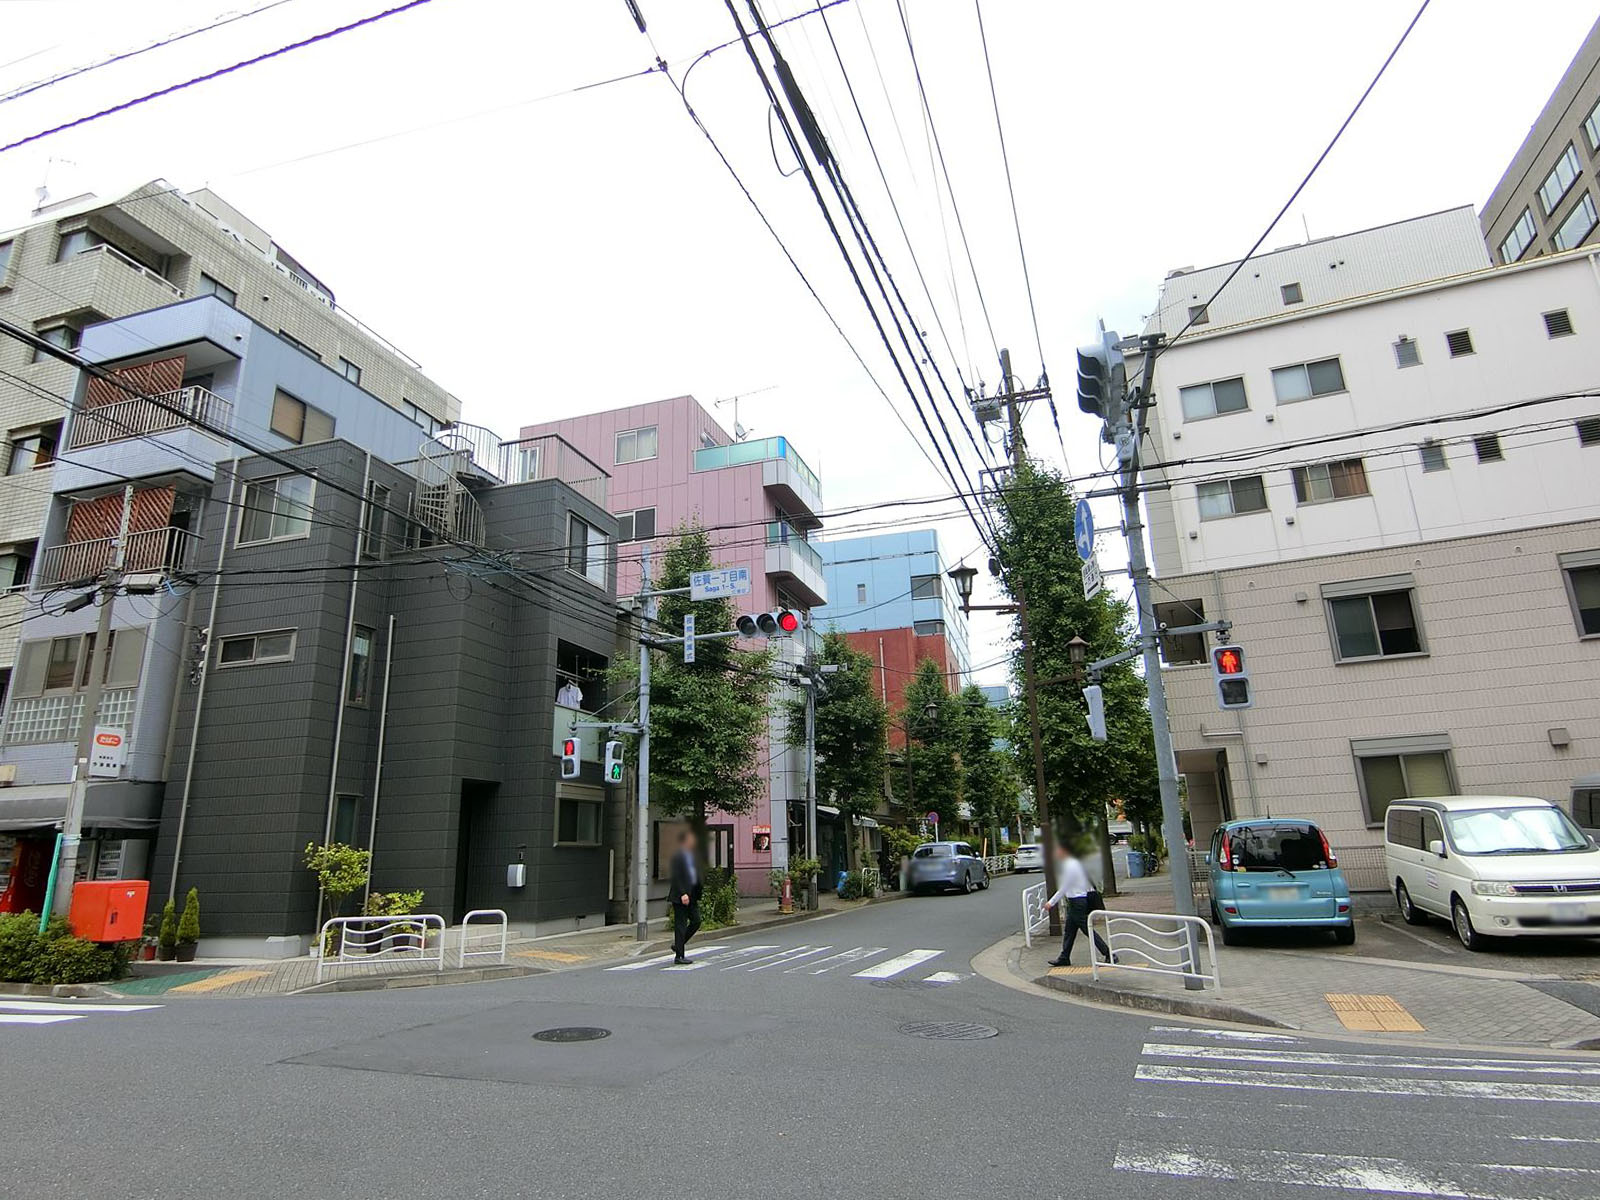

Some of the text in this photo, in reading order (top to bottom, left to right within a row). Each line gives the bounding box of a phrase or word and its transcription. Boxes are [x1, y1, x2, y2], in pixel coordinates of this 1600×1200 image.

[693, 569, 747, 587] 佐賀一丁目南
